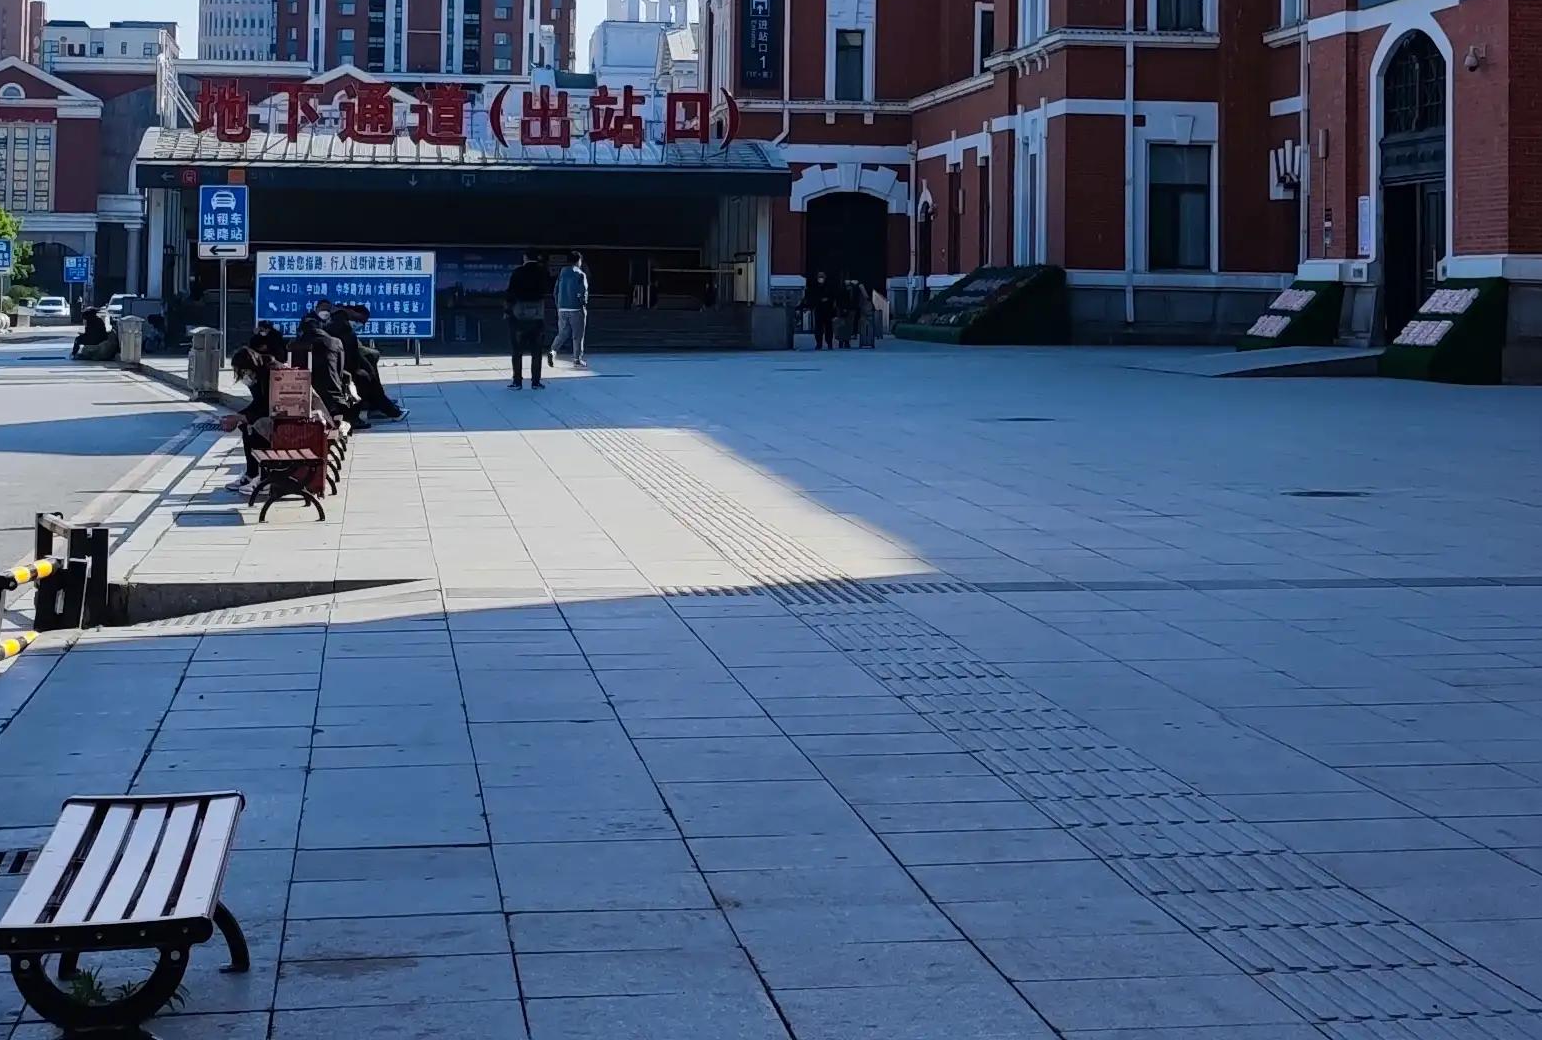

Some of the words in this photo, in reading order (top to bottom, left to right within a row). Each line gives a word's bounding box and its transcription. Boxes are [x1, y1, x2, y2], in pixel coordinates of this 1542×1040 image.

[193, 77, 740, 150] 地下通道(出站口)
[203, 212, 243, 226] 出租车
[203, 227, 243, 241] 乘降站
